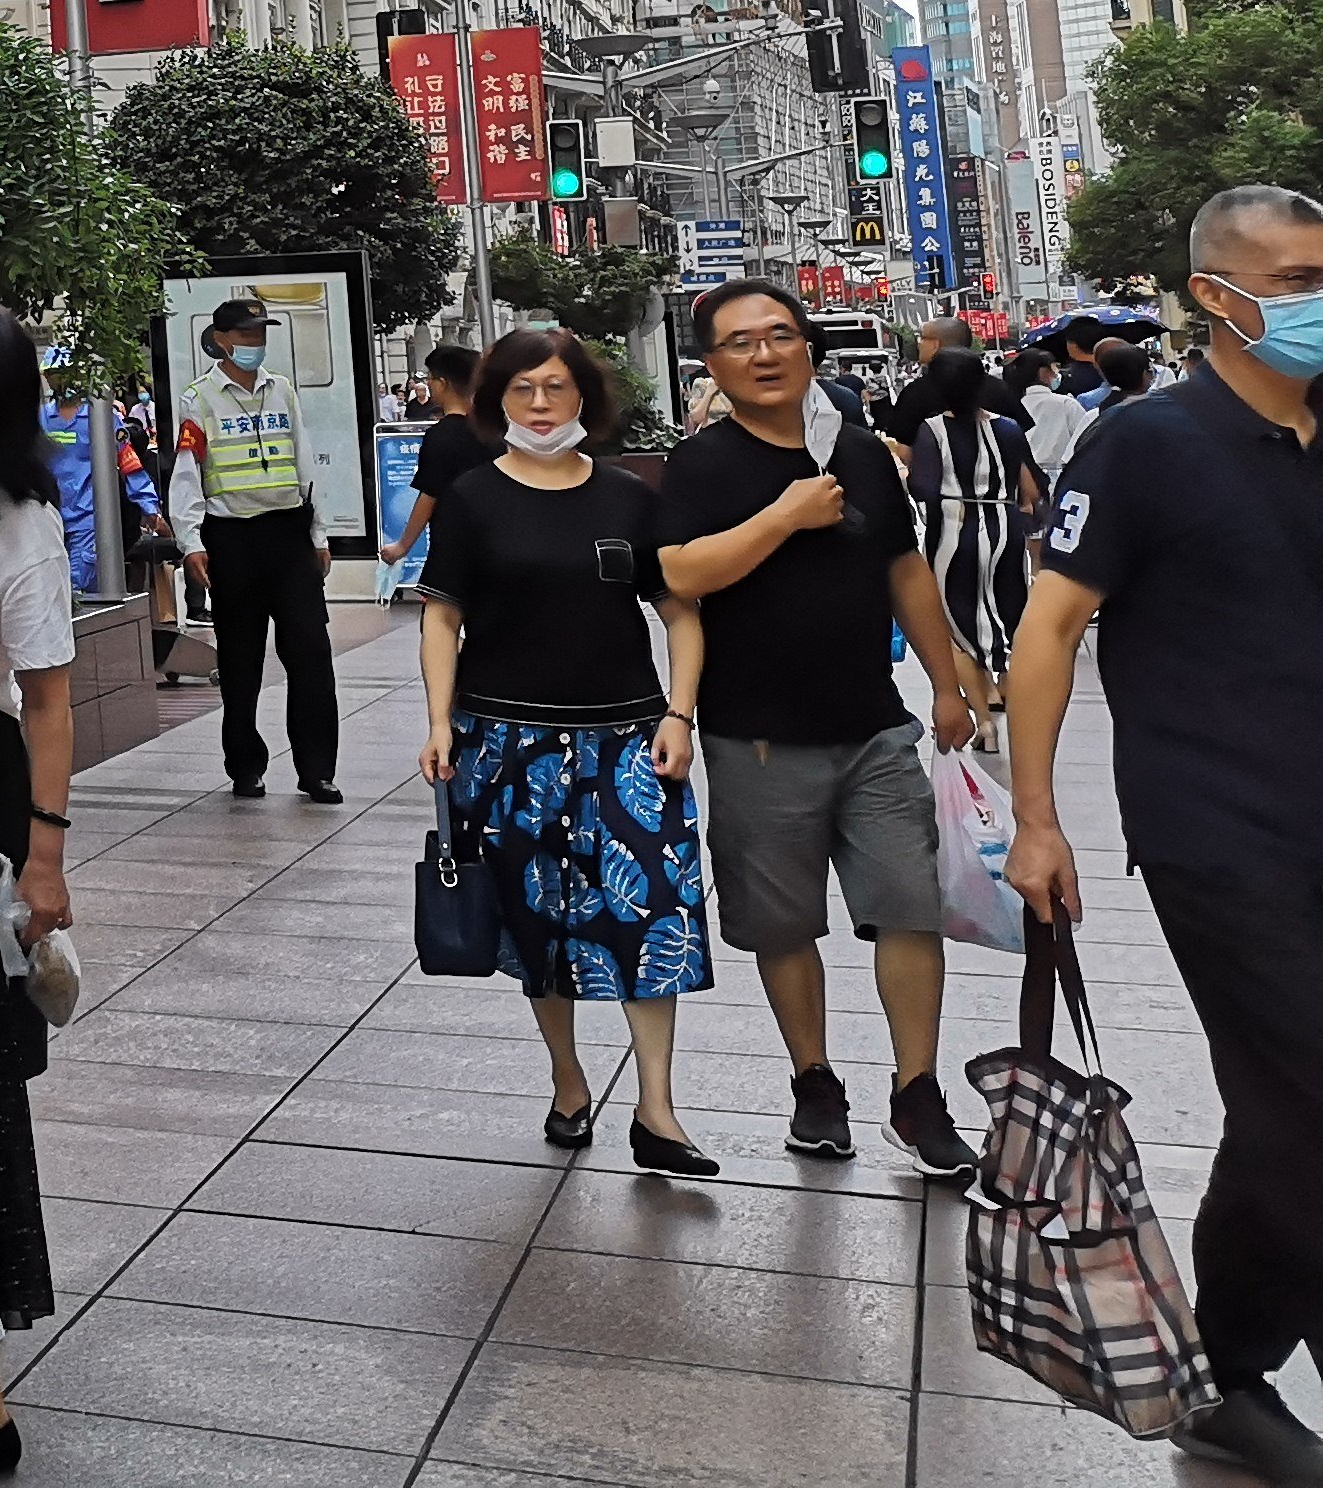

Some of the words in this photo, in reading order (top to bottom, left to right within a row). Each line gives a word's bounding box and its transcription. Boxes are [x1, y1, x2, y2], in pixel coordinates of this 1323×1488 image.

[480, 74, 505, 114] 文明
[506, 72, 530, 112] 富强
[485, 123, 509, 164] 和谐
[510, 123, 532, 162] 民主
[860, 188, 881, 215] 大王
[1041, 157, 1062, 252] BOSIDENG
[703, 239, 736, 248] 人民广场
[1015, 211, 1035, 267] Baleno
[312, 453, 331, 466] 列
[1049, 489, 1092, 554] 3
